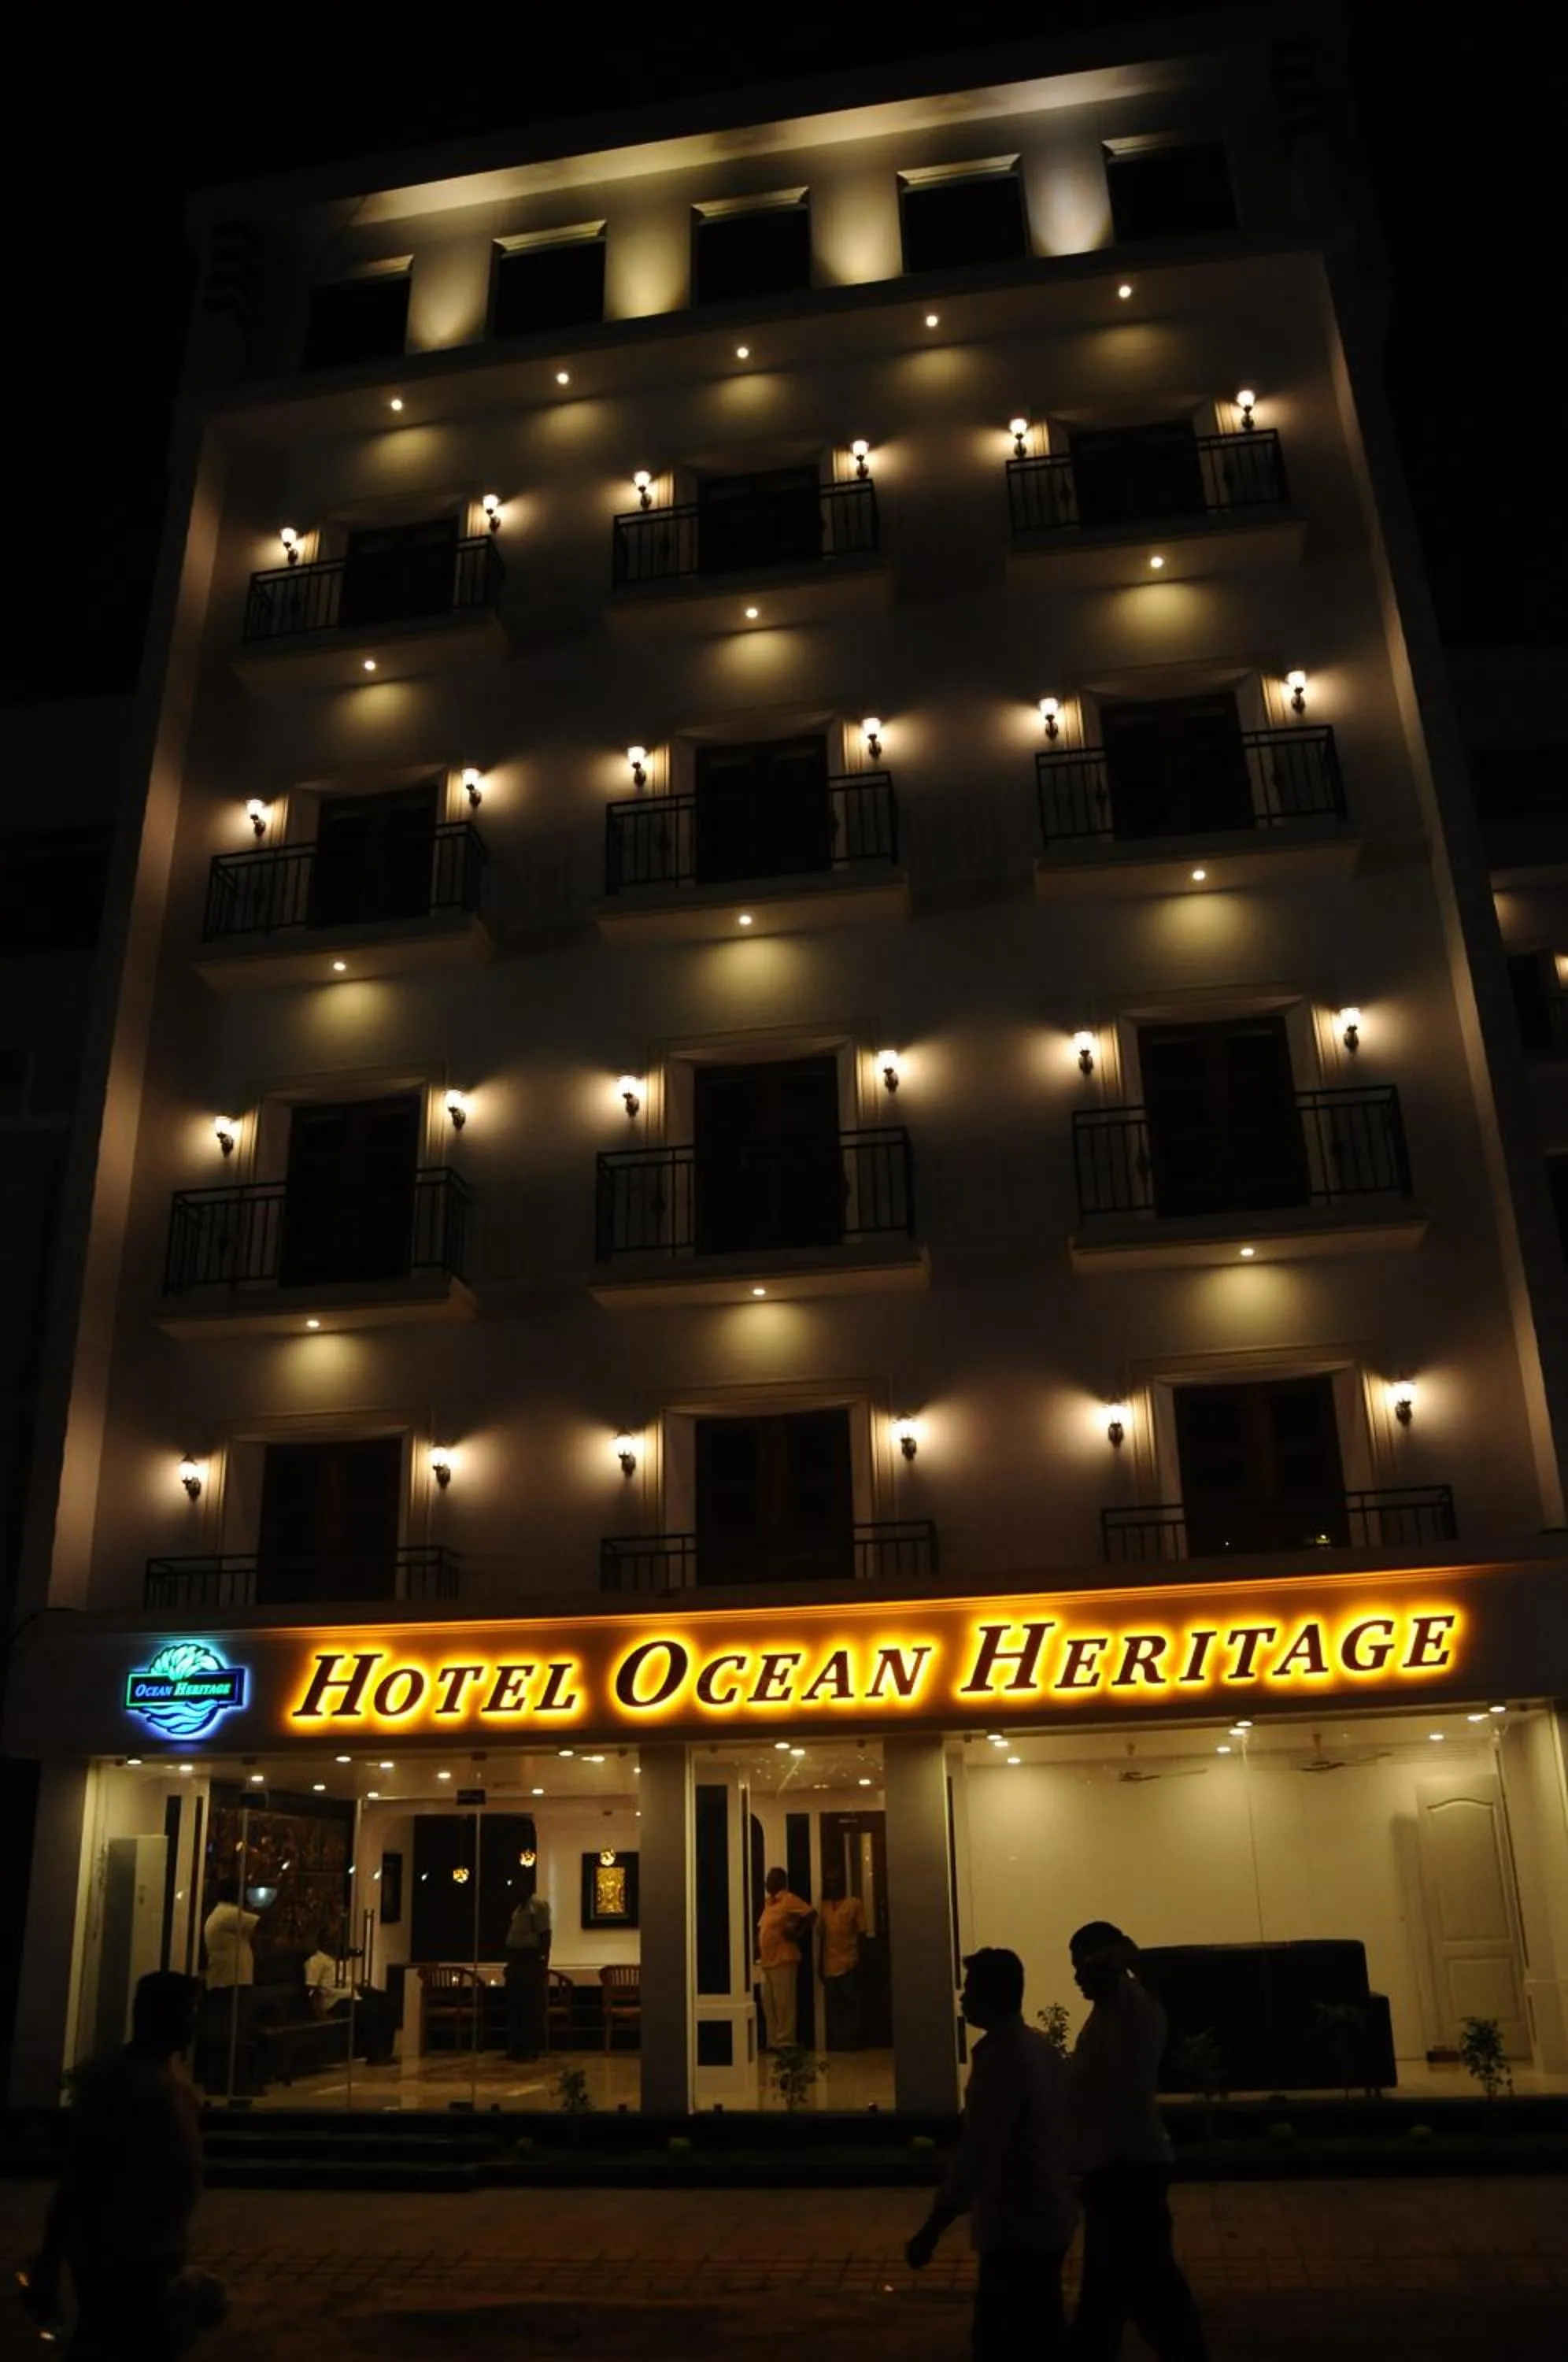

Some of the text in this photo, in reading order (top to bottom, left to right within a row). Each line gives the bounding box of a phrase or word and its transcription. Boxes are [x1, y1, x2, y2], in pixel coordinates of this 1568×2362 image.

[135, 1682, 231, 1697] OCEAN HERITAGE
[292, 1616, 1455, 1717] HOTEL OCEAN HERITAGE
